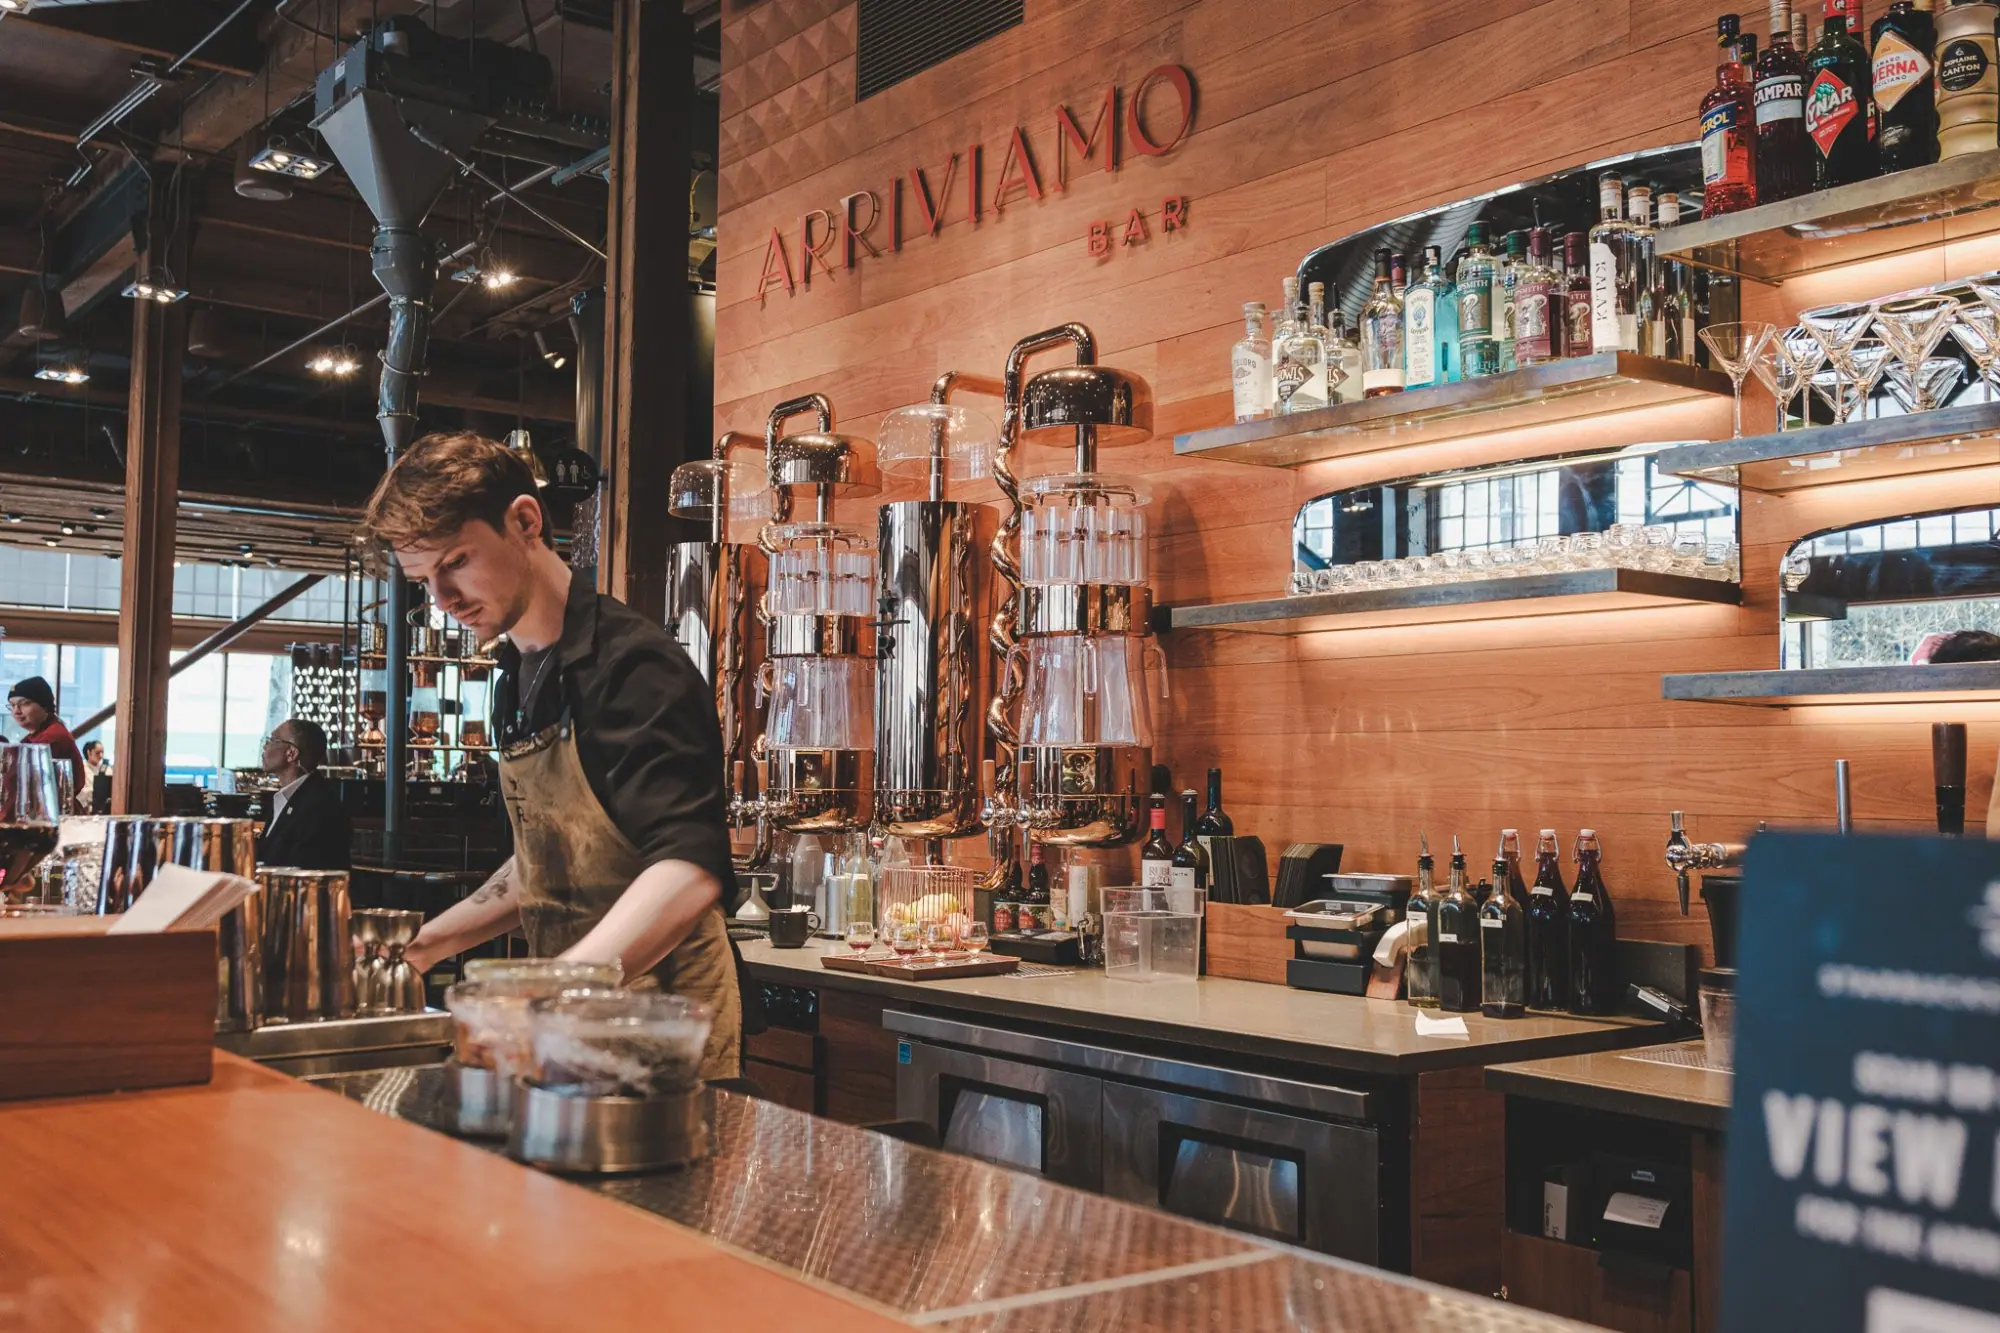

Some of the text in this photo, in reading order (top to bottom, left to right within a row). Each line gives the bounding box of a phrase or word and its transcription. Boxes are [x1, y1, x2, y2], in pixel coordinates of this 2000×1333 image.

[1872, 59, 1919, 84] VERNA
[1942, 63, 1980, 77] CANTON
[1944, 55, 1977, 67] DOMAINE
[1754, 83, 1803, 106] CAMPAR
[1806, 86, 1852, 133] CYNAR
[756, 64, 1193, 301] ARRIVIAMO
[1087, 197, 1188, 257] BAR
[1762, 1088, 1968, 1210] VIEW
